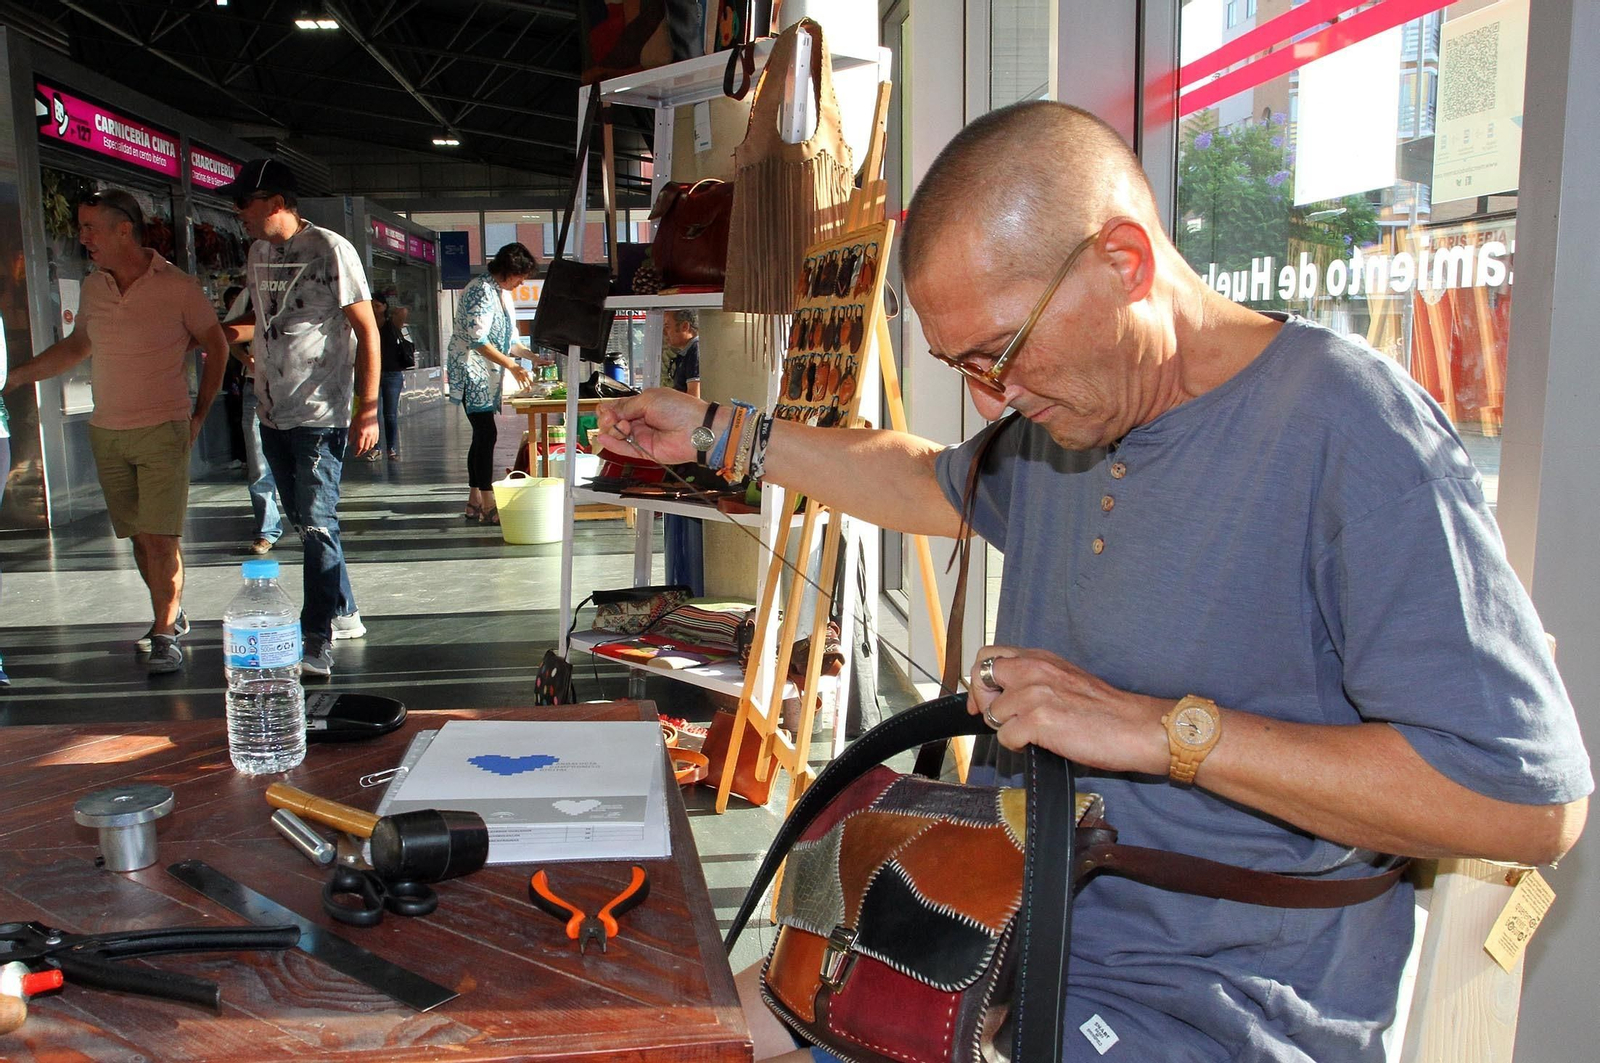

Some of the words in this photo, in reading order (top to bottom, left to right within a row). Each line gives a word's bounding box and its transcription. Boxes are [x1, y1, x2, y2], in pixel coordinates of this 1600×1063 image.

[77, 125, 91, 142] 127
[95, 113, 151, 149] CARNICERÍA
[152, 136, 176, 158] CINTA
[191, 152, 235, 180] CHARCUTERÍA
